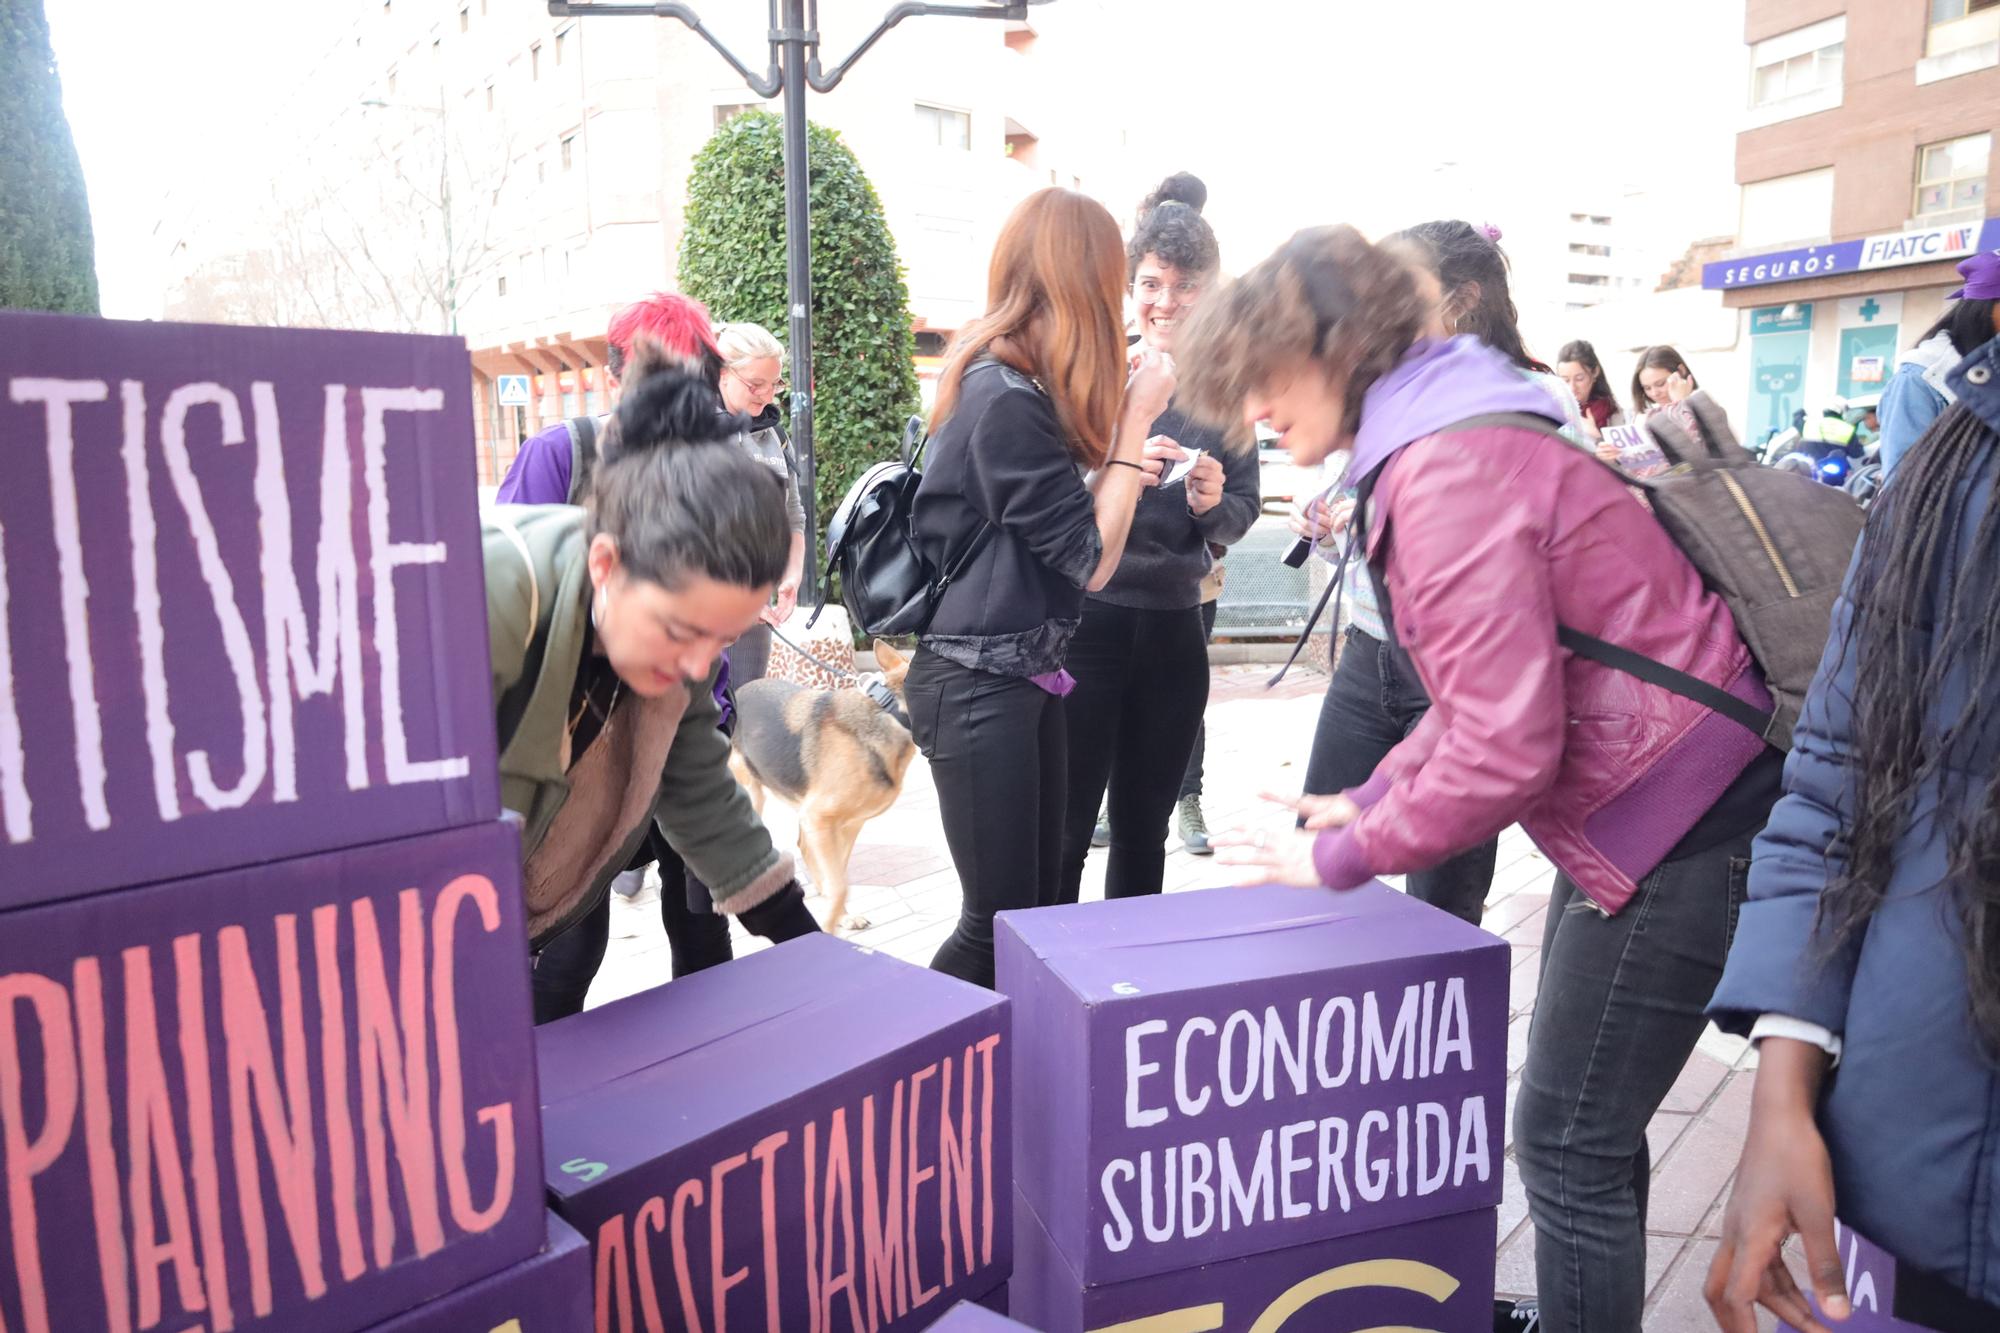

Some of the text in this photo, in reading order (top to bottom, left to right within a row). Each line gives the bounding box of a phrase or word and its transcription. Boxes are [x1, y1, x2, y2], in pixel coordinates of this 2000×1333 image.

[1724, 232, 1941, 284] SEGUROS FIATC
[1610, 425, 1645, 449] 8M
[0, 378, 469, 843] TISME
[0, 873, 516, 1333] PLAINING
[1125, 976, 1475, 1128] ECONOMIA
[1101, 1095, 1492, 1253] SUBMERGIDA
